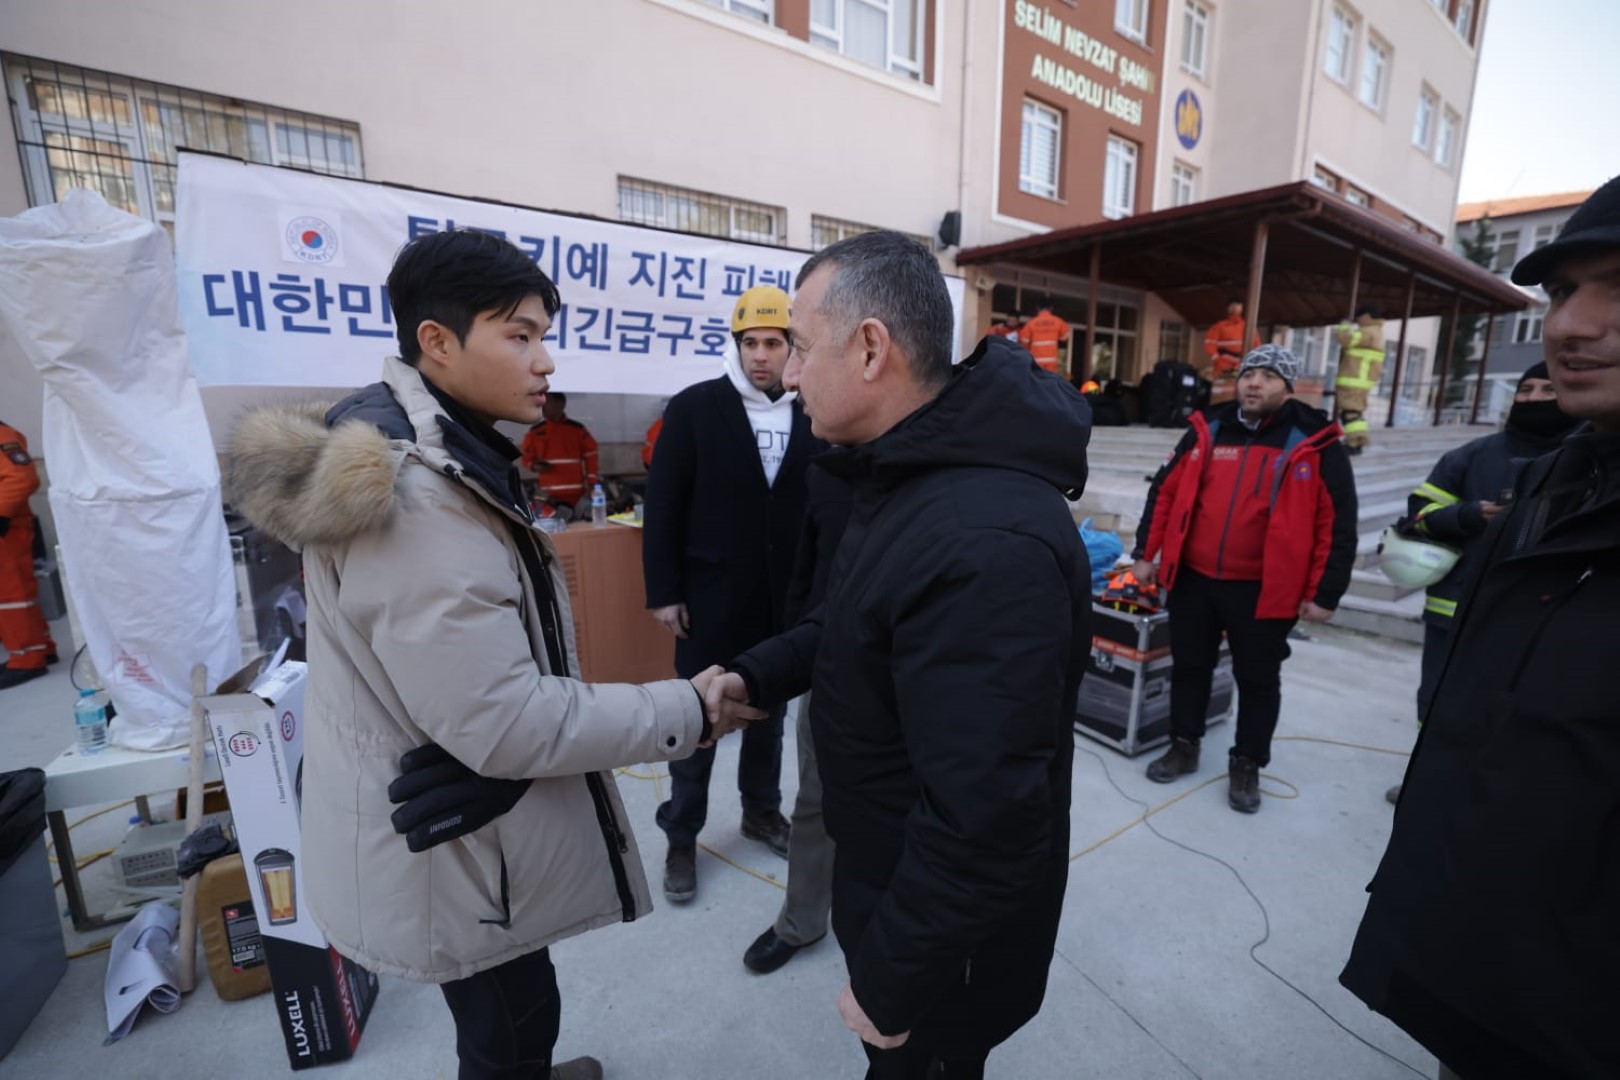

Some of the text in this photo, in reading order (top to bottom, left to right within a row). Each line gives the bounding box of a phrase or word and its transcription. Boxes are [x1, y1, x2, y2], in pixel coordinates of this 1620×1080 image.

[1014, 0, 1063, 46] SELİM
[1064, 25, 1118, 74] NEVZAT
[1031, 54, 1104, 108] ANADOLU
[408, 215, 608, 290] 키예
[628, 250, 707, 300] 지진
[203, 270, 394, 338] 대한민
[286, 990, 311, 1056] LUXELL
